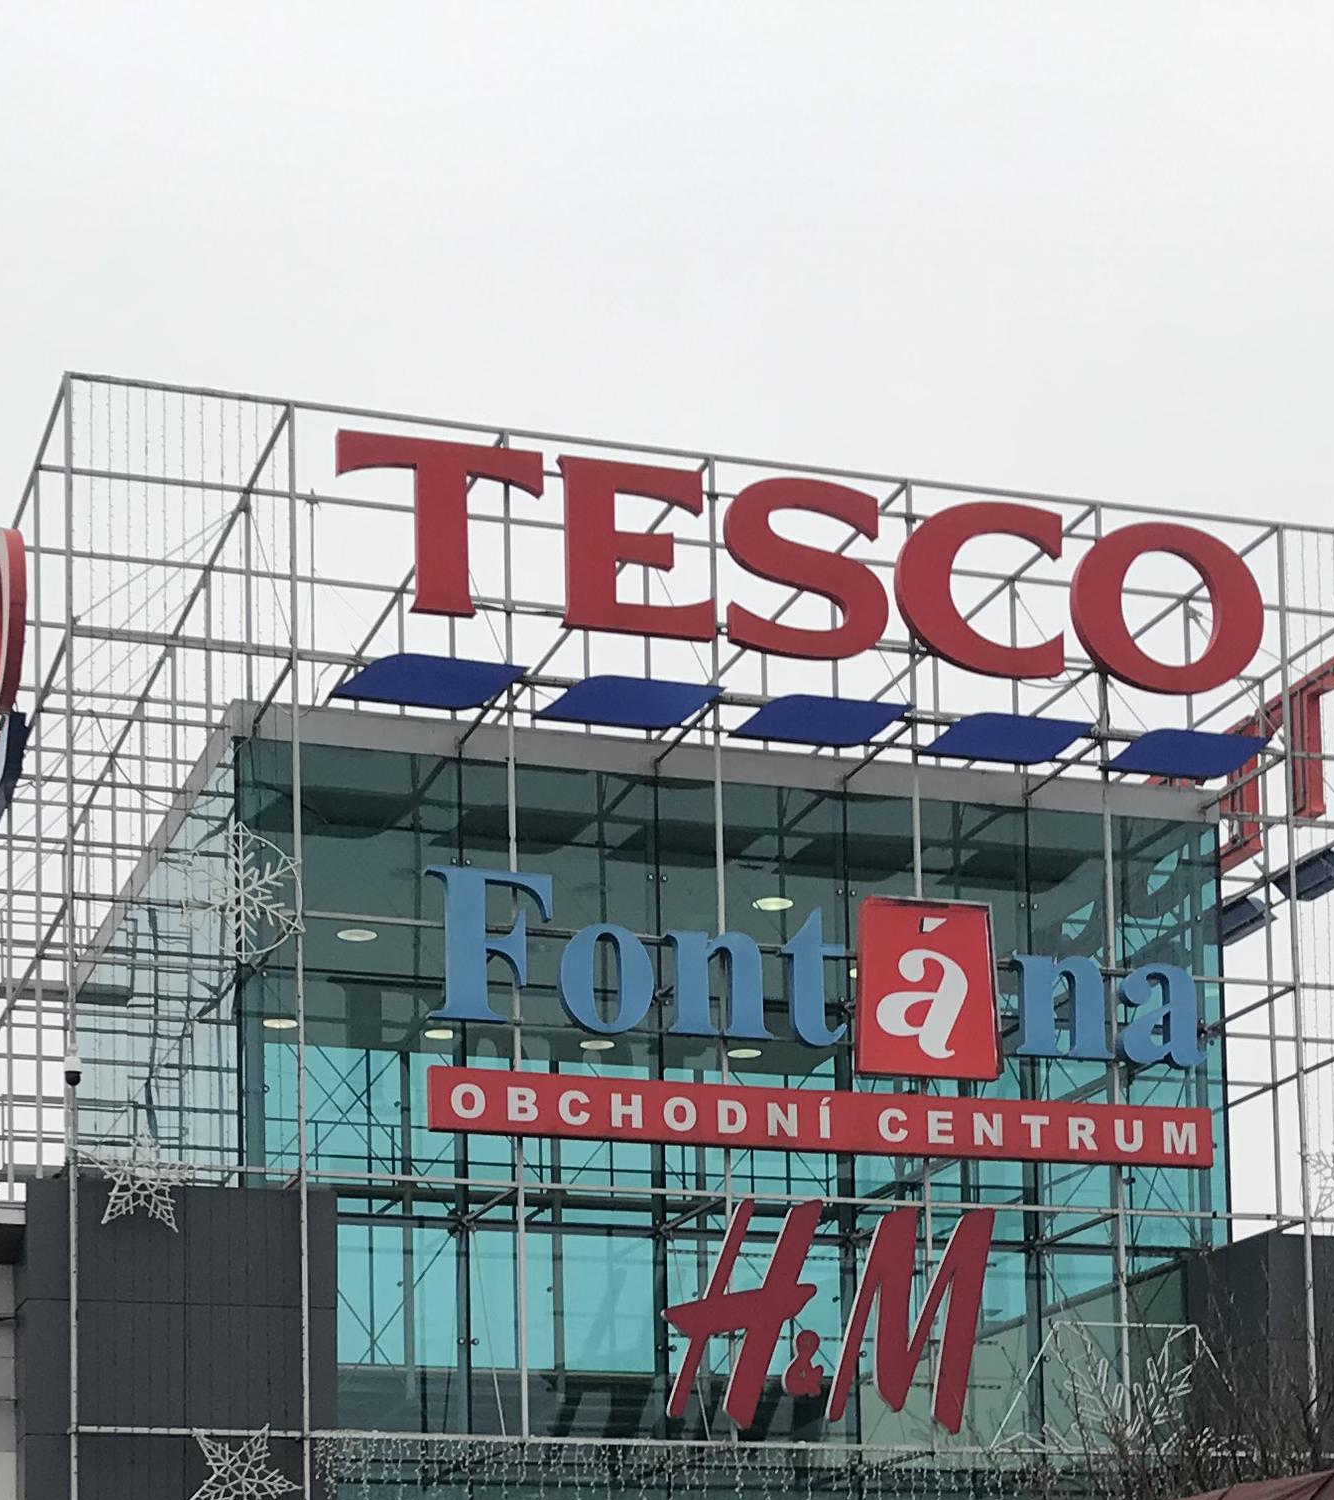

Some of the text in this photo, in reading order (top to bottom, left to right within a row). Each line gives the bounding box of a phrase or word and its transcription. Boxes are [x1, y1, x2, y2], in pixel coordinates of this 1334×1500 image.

[336, 429, 1265, 696] TESCO
[424, 865, 1208, 1070] Fontána
[450, 1082, 1199, 1156] OBCHODNÍ CENTRUM
[662, 1199, 996, 1436] H&M
